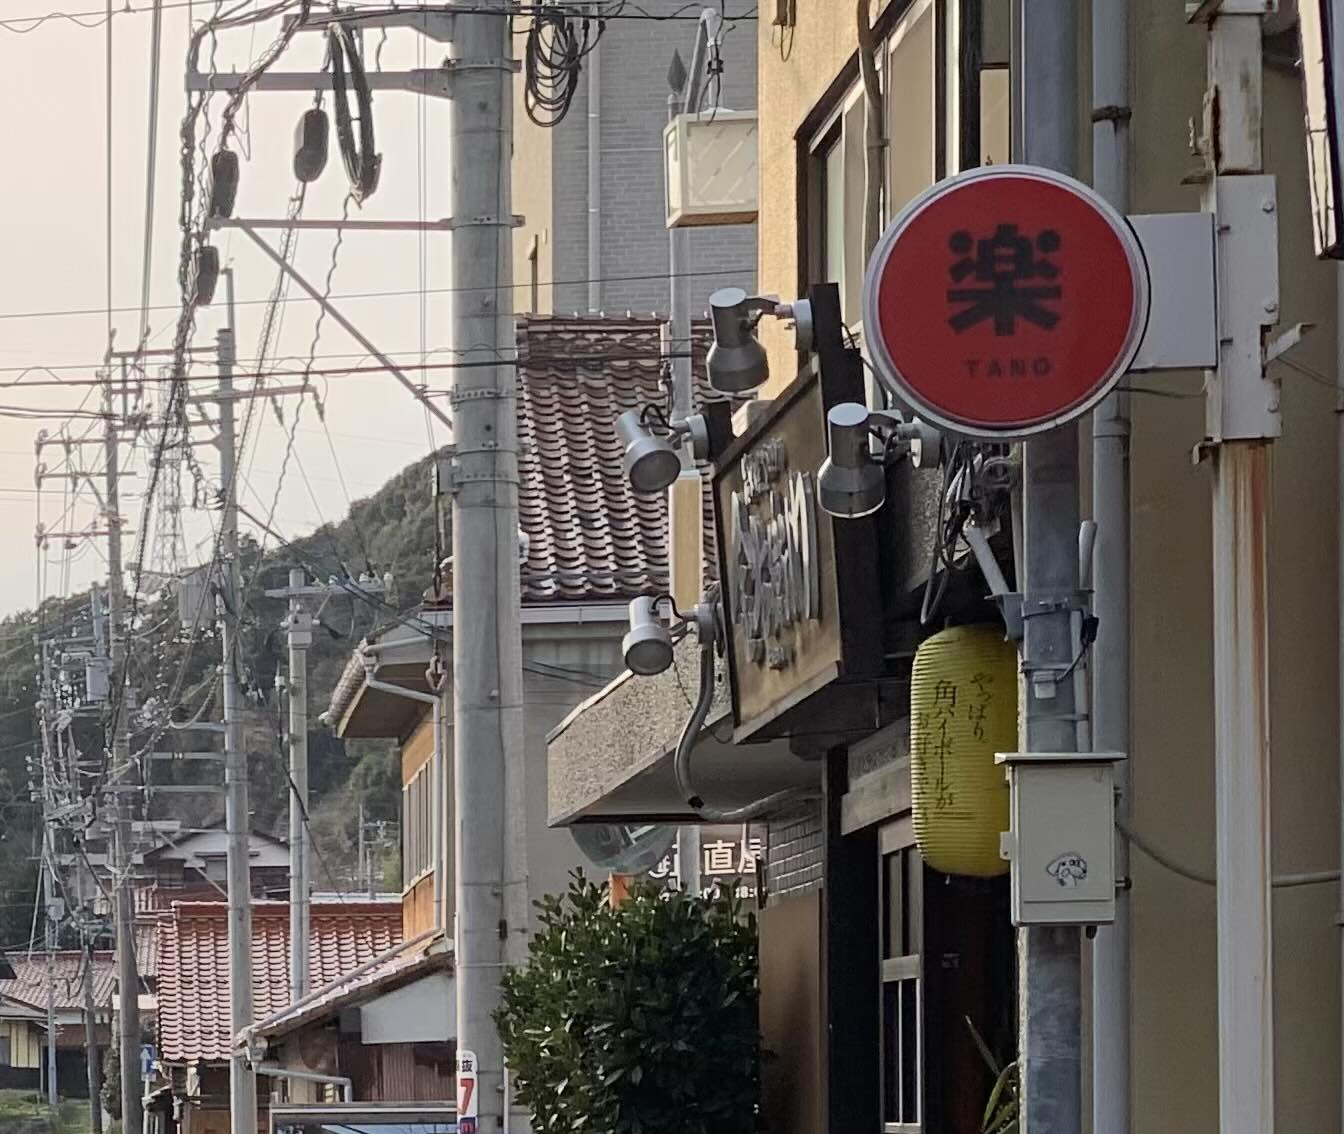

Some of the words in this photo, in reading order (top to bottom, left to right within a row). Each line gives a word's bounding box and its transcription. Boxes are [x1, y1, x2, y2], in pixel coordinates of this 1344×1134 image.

[946, 223, 1062, 337] 楽
[964, 359, 1052, 378] TANO
[932, 679, 958, 811] 角ハイボールが
[460, 1078, 474, 1116] 7
